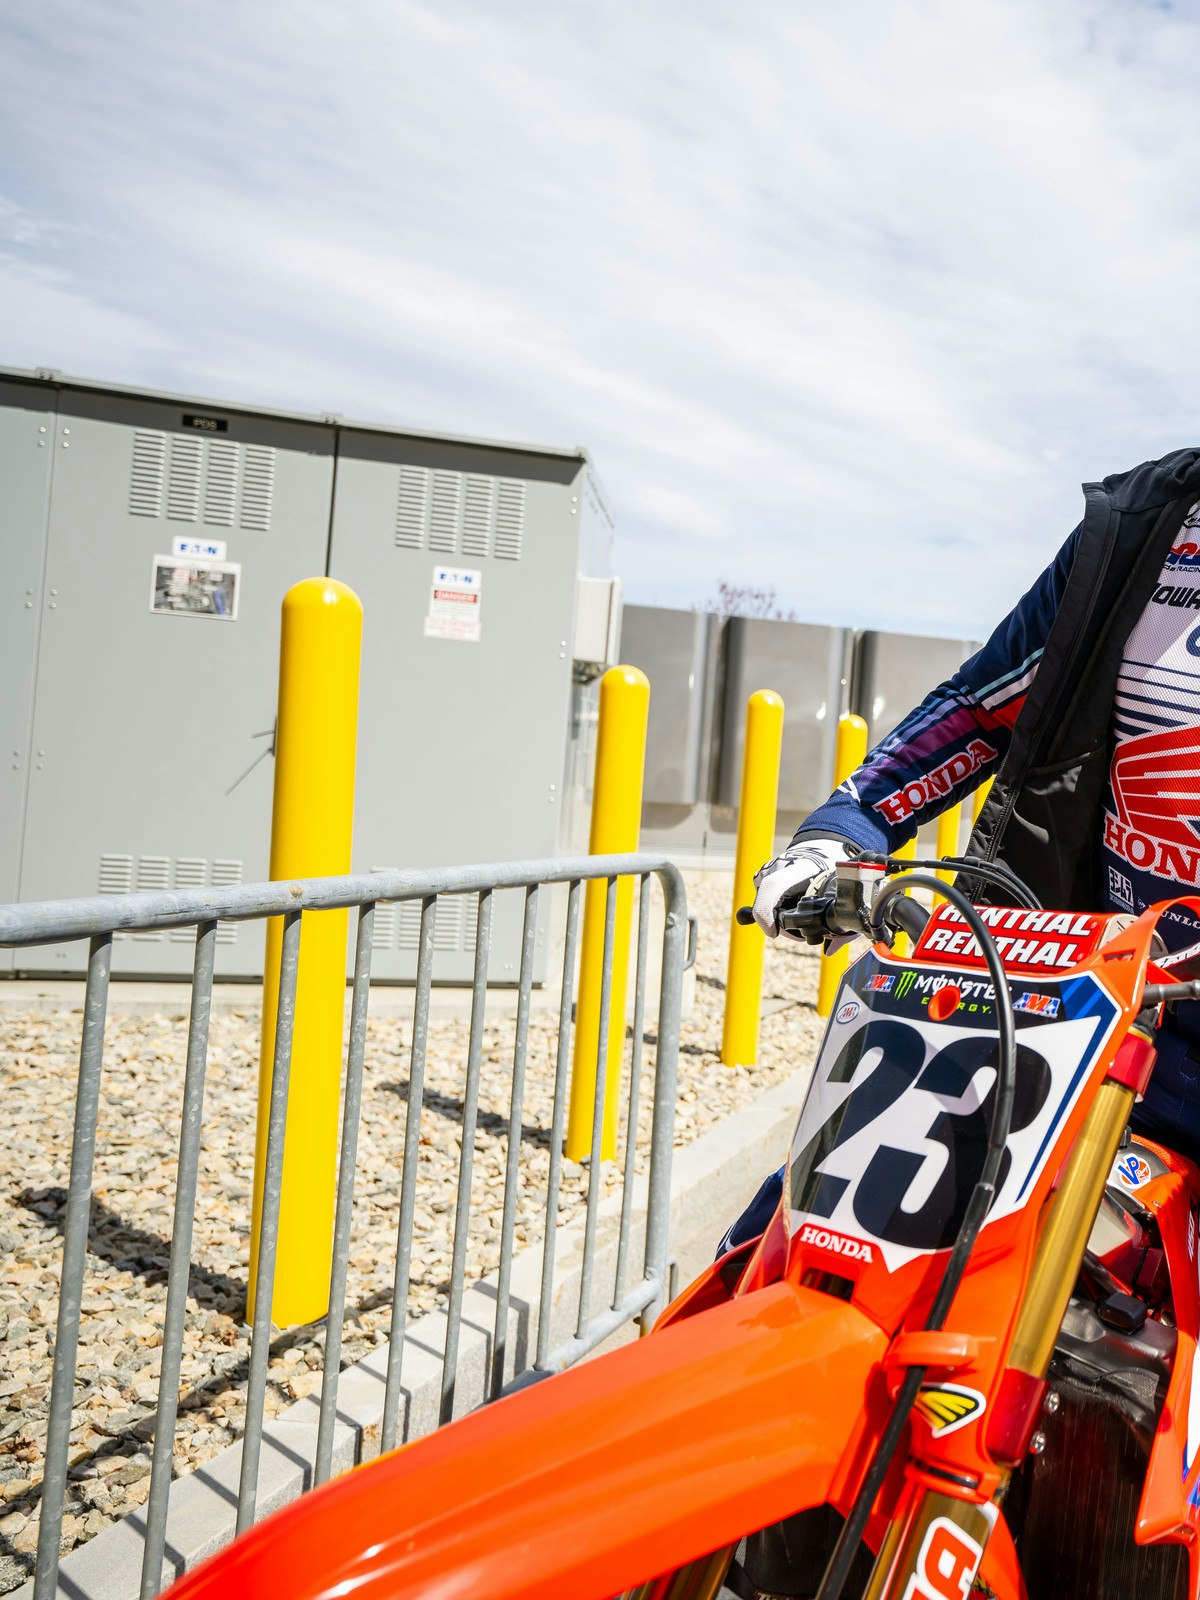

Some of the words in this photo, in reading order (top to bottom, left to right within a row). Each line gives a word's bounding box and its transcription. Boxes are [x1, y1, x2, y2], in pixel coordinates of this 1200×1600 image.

[440, 573, 473, 583] ETN
[872, 738, 999, 827] HONDA
[923, 928, 1078, 968] RENTHAL
[861, 974, 897, 993] AMA
[914, 972, 1011, 1001] MOSTE
[921, 997, 991, 1014] ERGY
[1012, 992, 1062, 1019] AMA
[790, 1020, 1052, 1249] 23
[1117, 1156, 1140, 1185] VP
[800, 1227, 873, 1263] HONDA
